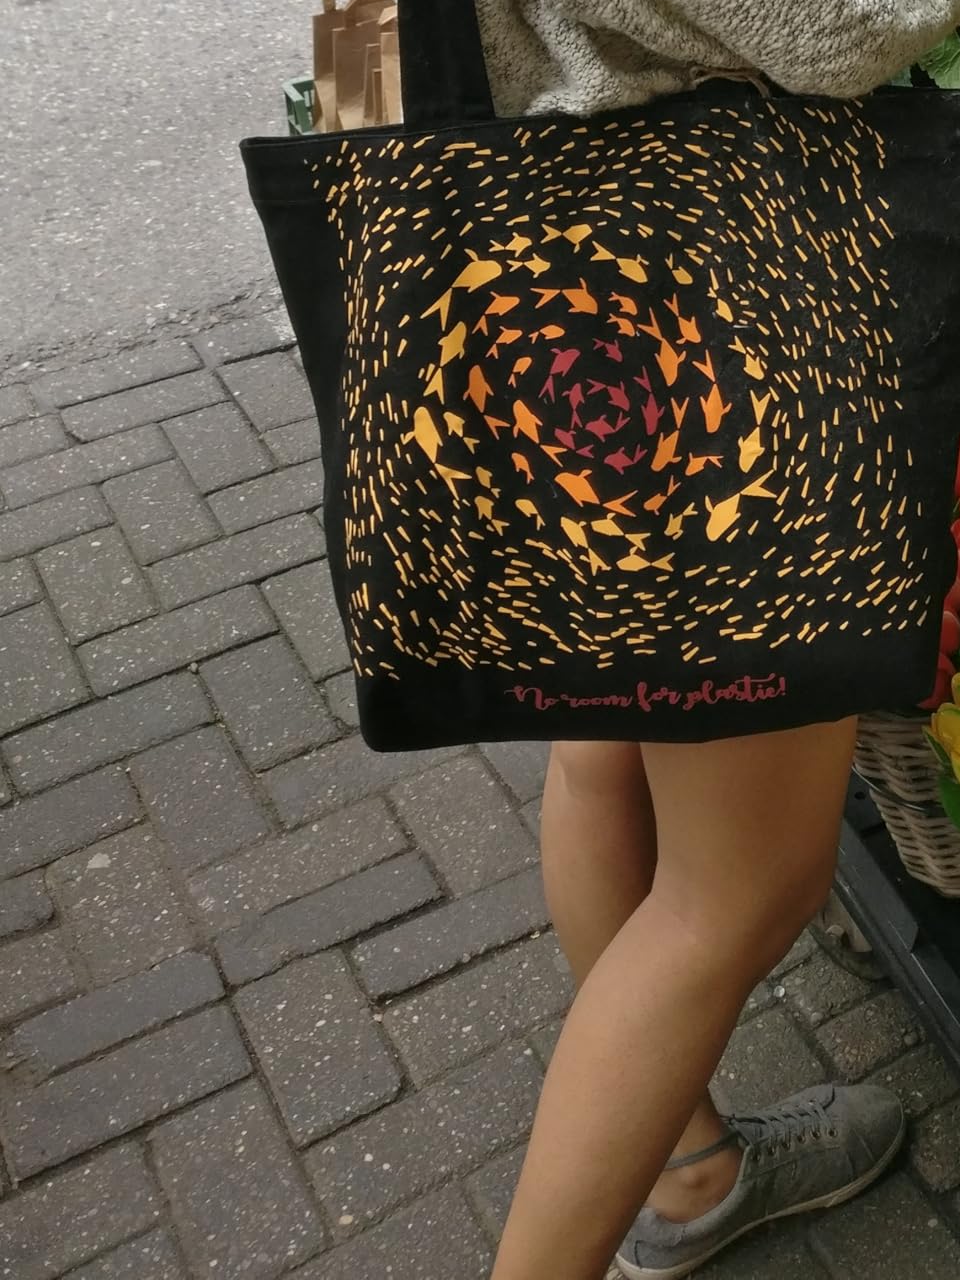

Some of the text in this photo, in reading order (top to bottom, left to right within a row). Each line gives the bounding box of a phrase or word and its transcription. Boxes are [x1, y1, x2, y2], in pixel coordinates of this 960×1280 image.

[560, 693, 632, 708] room
[636, 681, 681, 712] for
[682, 673, 786, 710] plastic!
